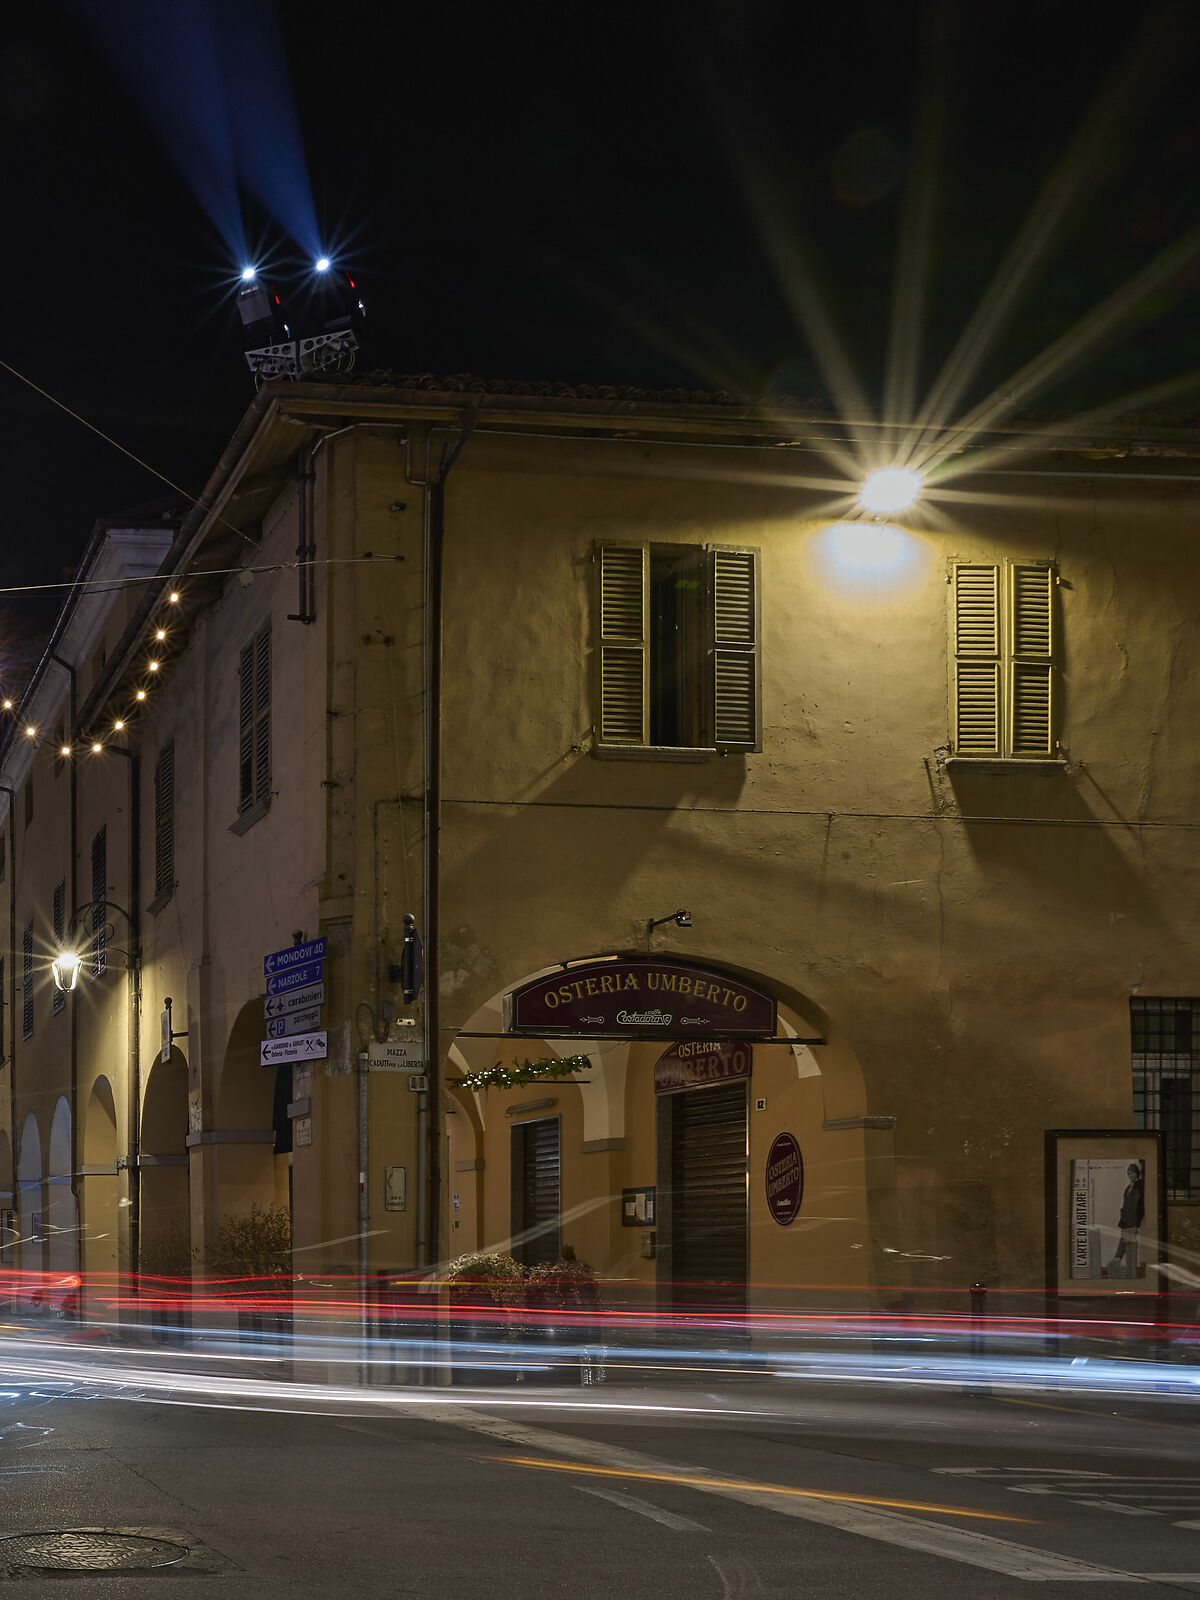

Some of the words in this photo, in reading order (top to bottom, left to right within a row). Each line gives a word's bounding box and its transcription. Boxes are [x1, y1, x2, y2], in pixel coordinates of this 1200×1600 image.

[314, 943, 324, 955] 40
[278, 970, 308, 988] NARZOLE
[315, 966, 320, 976] 7
[287, 989, 322, 1007] carabinieri
[544, 973, 640, 1009] OSTERIA
[647, 973, 748, 1012] UMBERTO
[616, 1010, 664, 1024] Costadoro
[386, 1048, 407, 1056] PIAZZA
[678, 1042, 722, 1058] OSTERIA
[370, 1059, 388, 1067] CADUTI
[660, 1051, 746, 1087] UMBERTO
[769, 1151, 798, 1180] OSTERIA
[768, 1166, 799, 1198] UMBERTO
[1076, 1191, 1087, 1226] ABITARE
[1077, 1228, 1087, 1236] DI
[1076, 1238, 1087, 1266] L'ARTE
